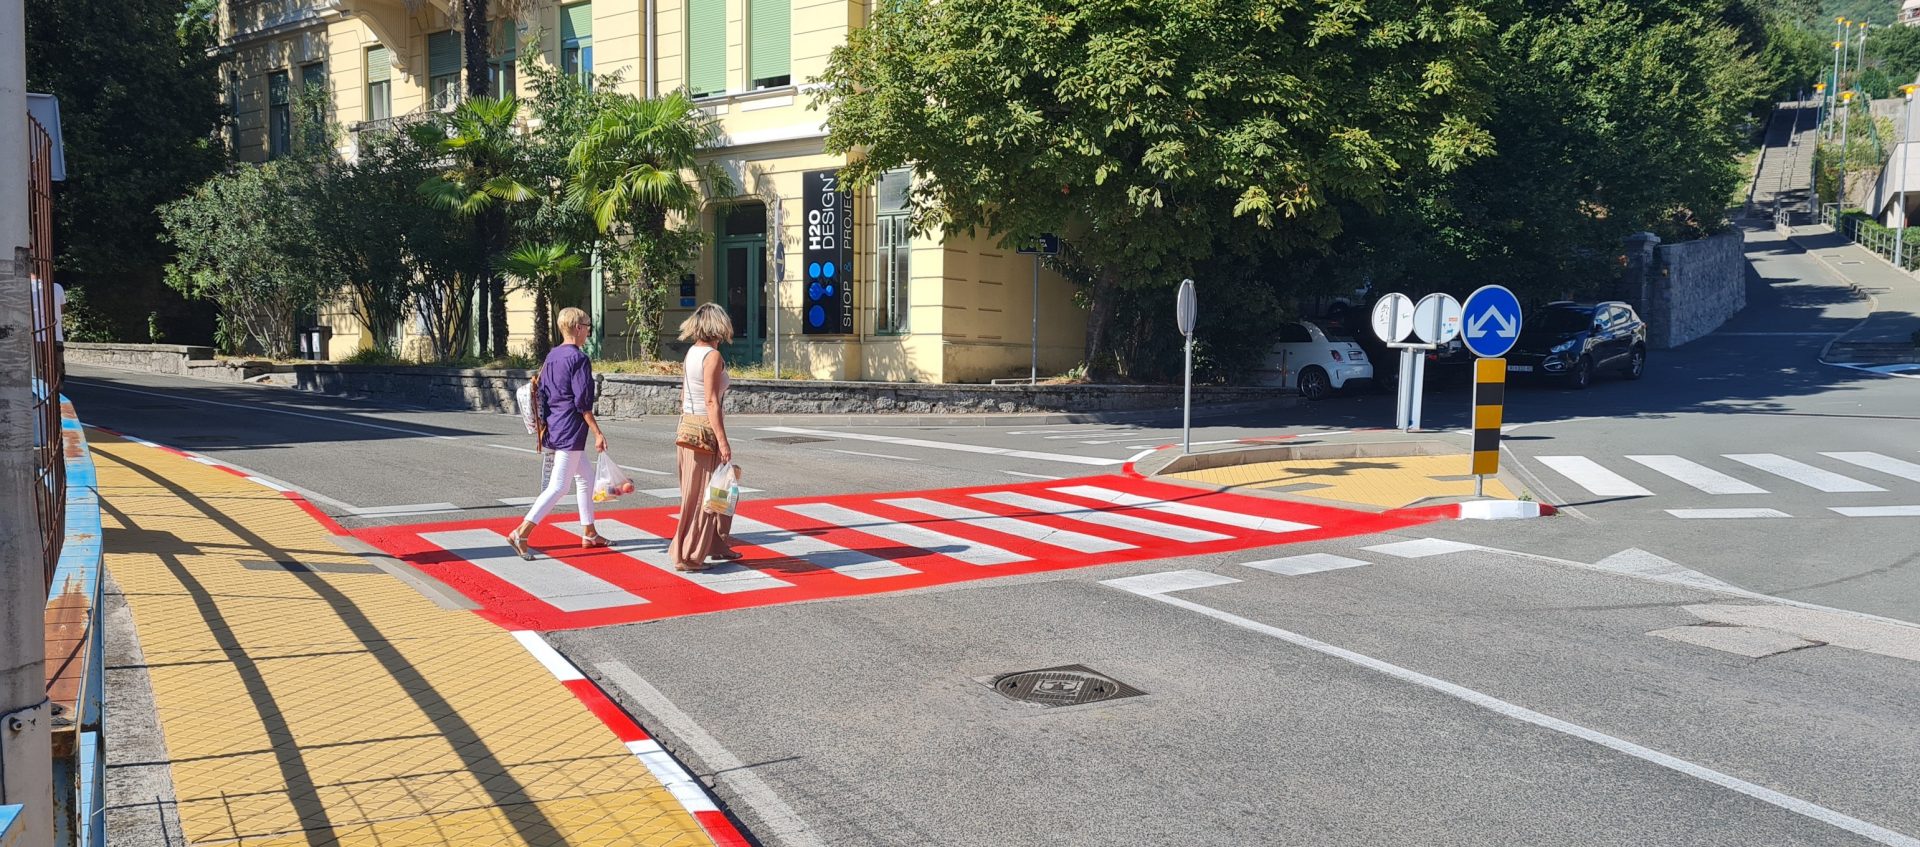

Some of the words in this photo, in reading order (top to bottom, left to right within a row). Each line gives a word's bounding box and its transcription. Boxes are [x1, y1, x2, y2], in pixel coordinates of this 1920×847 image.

[808, 210, 821, 250] H2O
[843, 183, 852, 249] PROJEC
[844, 262, 851, 272] &
[843, 281, 852, 327] SHOP
